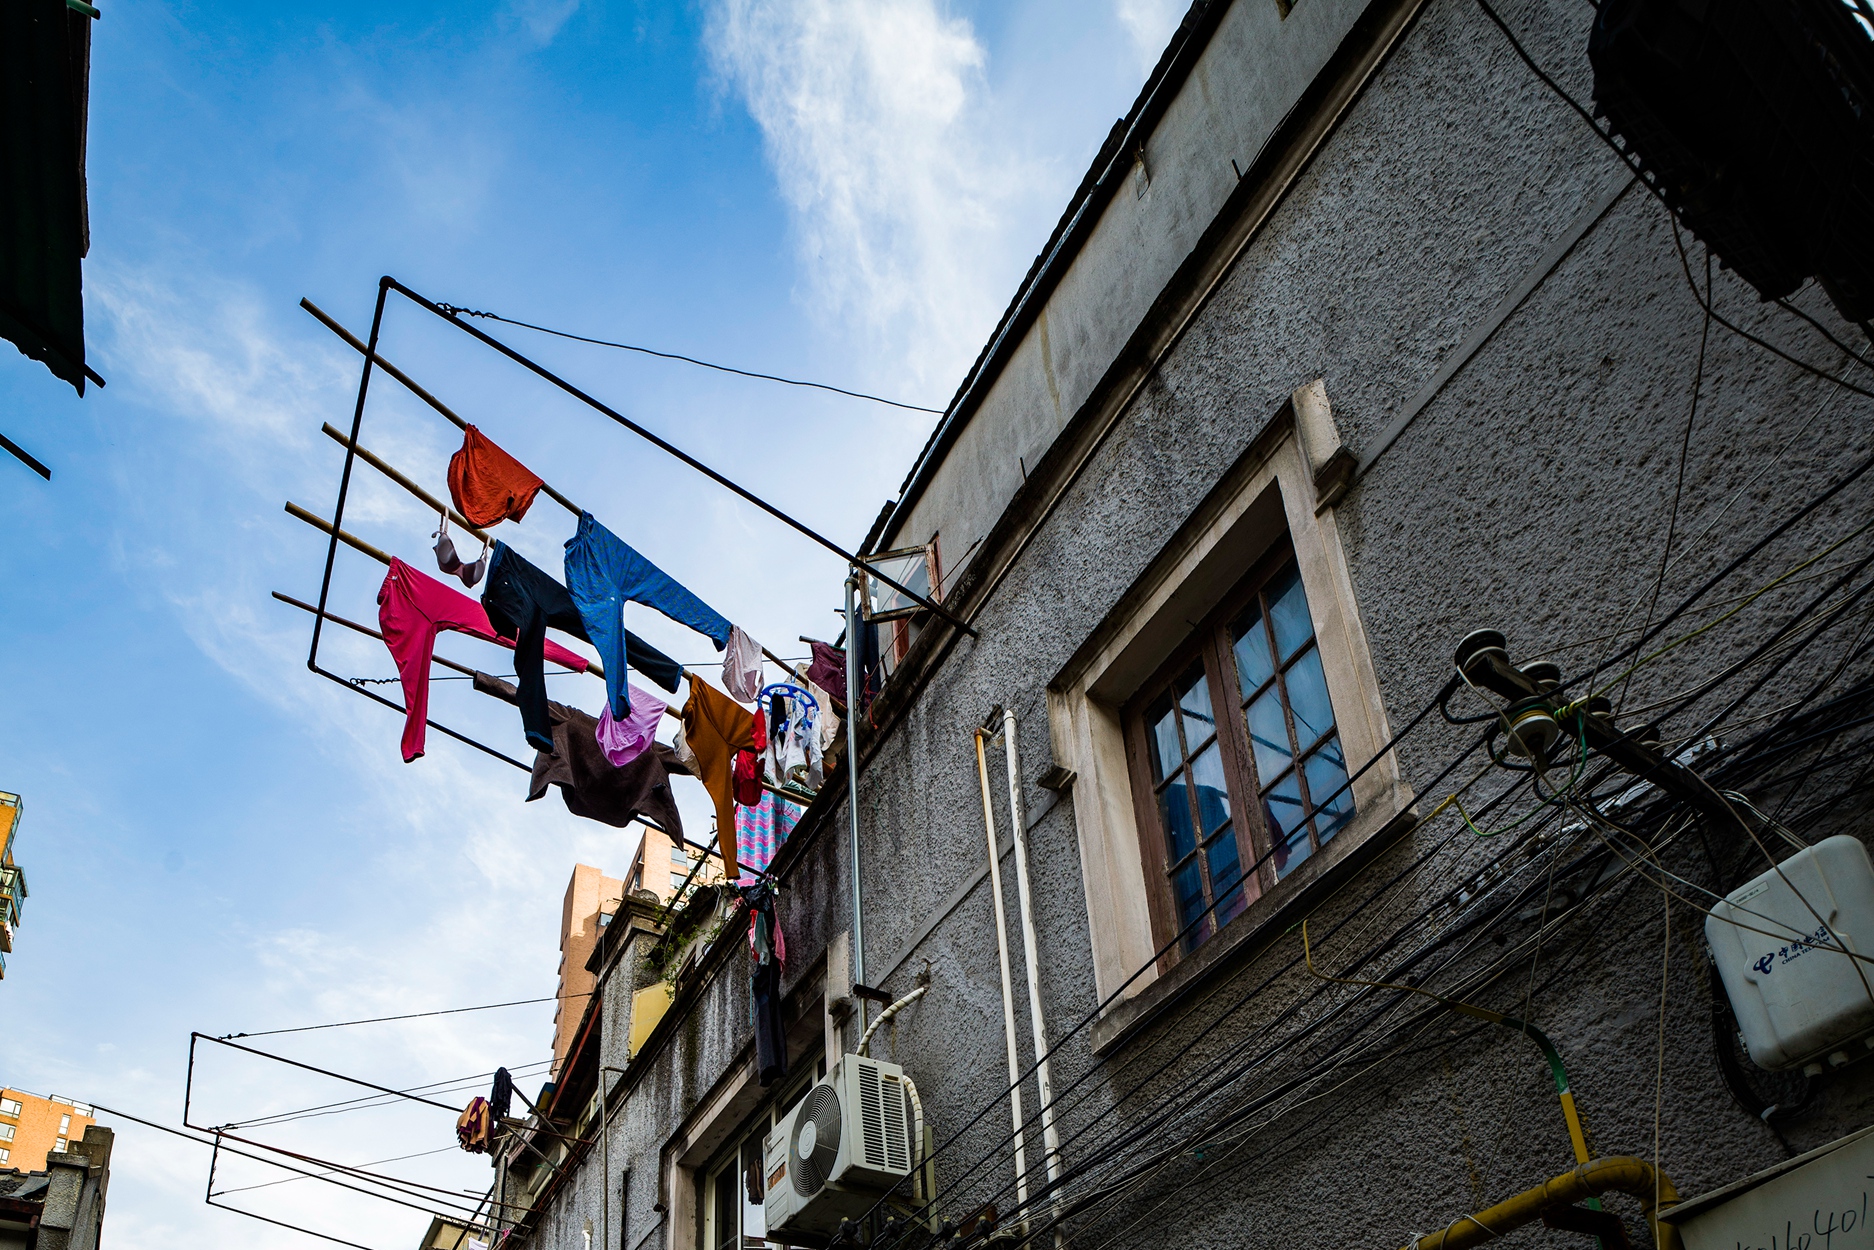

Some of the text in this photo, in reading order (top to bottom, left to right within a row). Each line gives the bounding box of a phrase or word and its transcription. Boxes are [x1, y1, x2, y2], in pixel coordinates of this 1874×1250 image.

[1778, 926, 1828, 958] 中国电信
[1782, 952, 1802, 965] CHINA
